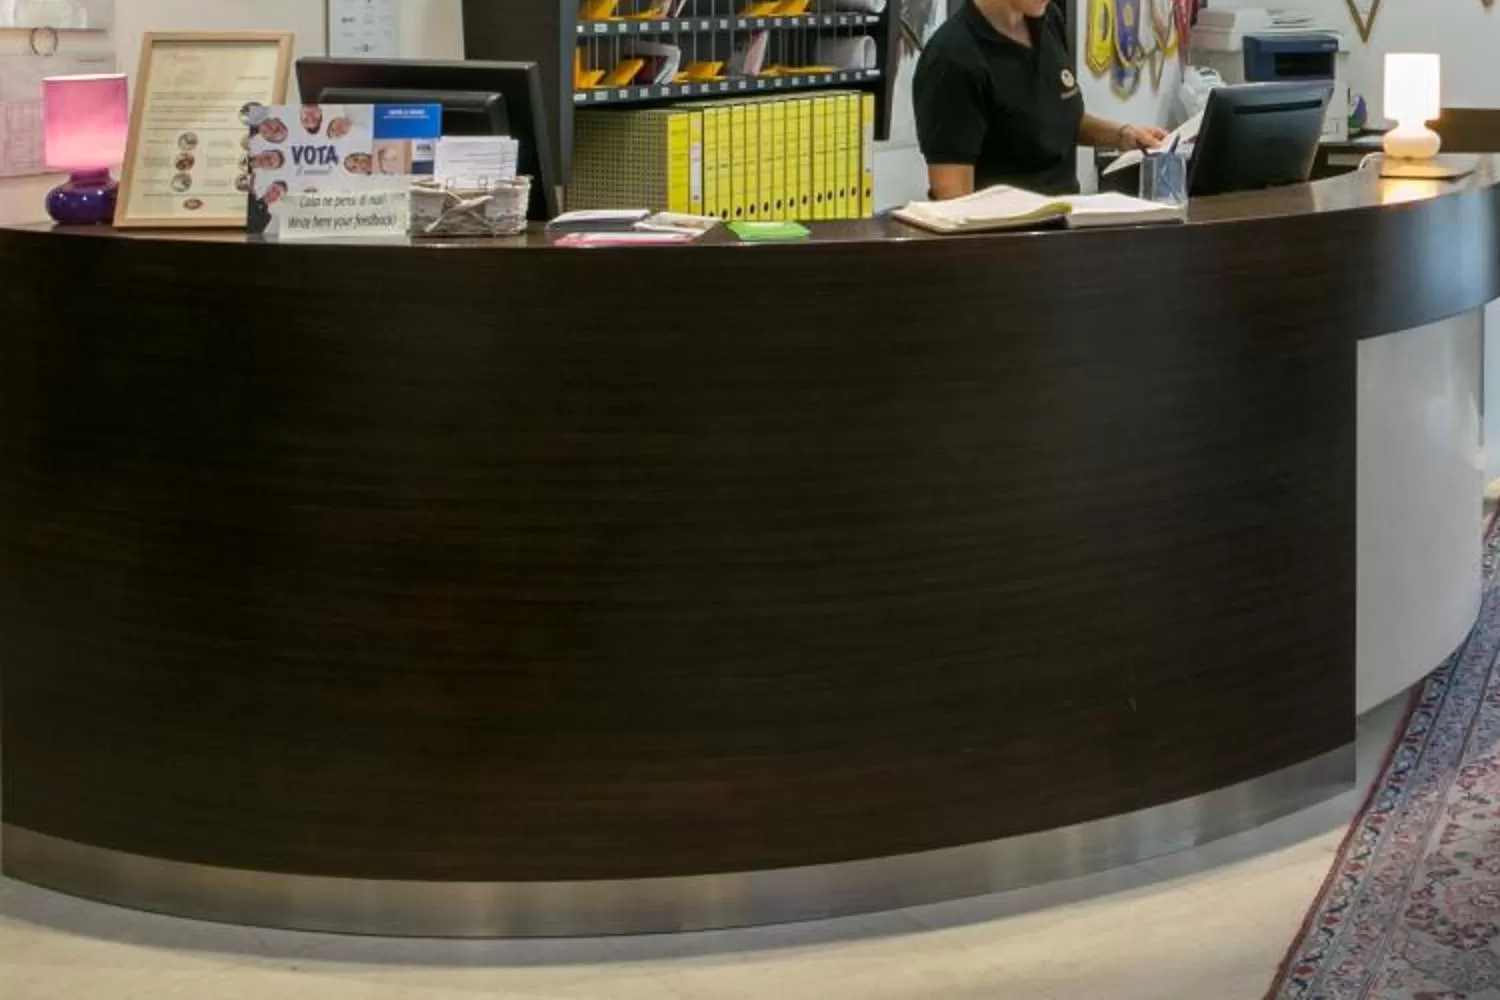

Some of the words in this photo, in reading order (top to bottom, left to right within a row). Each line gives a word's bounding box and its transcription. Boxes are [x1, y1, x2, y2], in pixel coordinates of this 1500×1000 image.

[291, 144, 339, 165] VOTA
[313, 215, 332, 228] here
[333, 216, 353, 230] your
